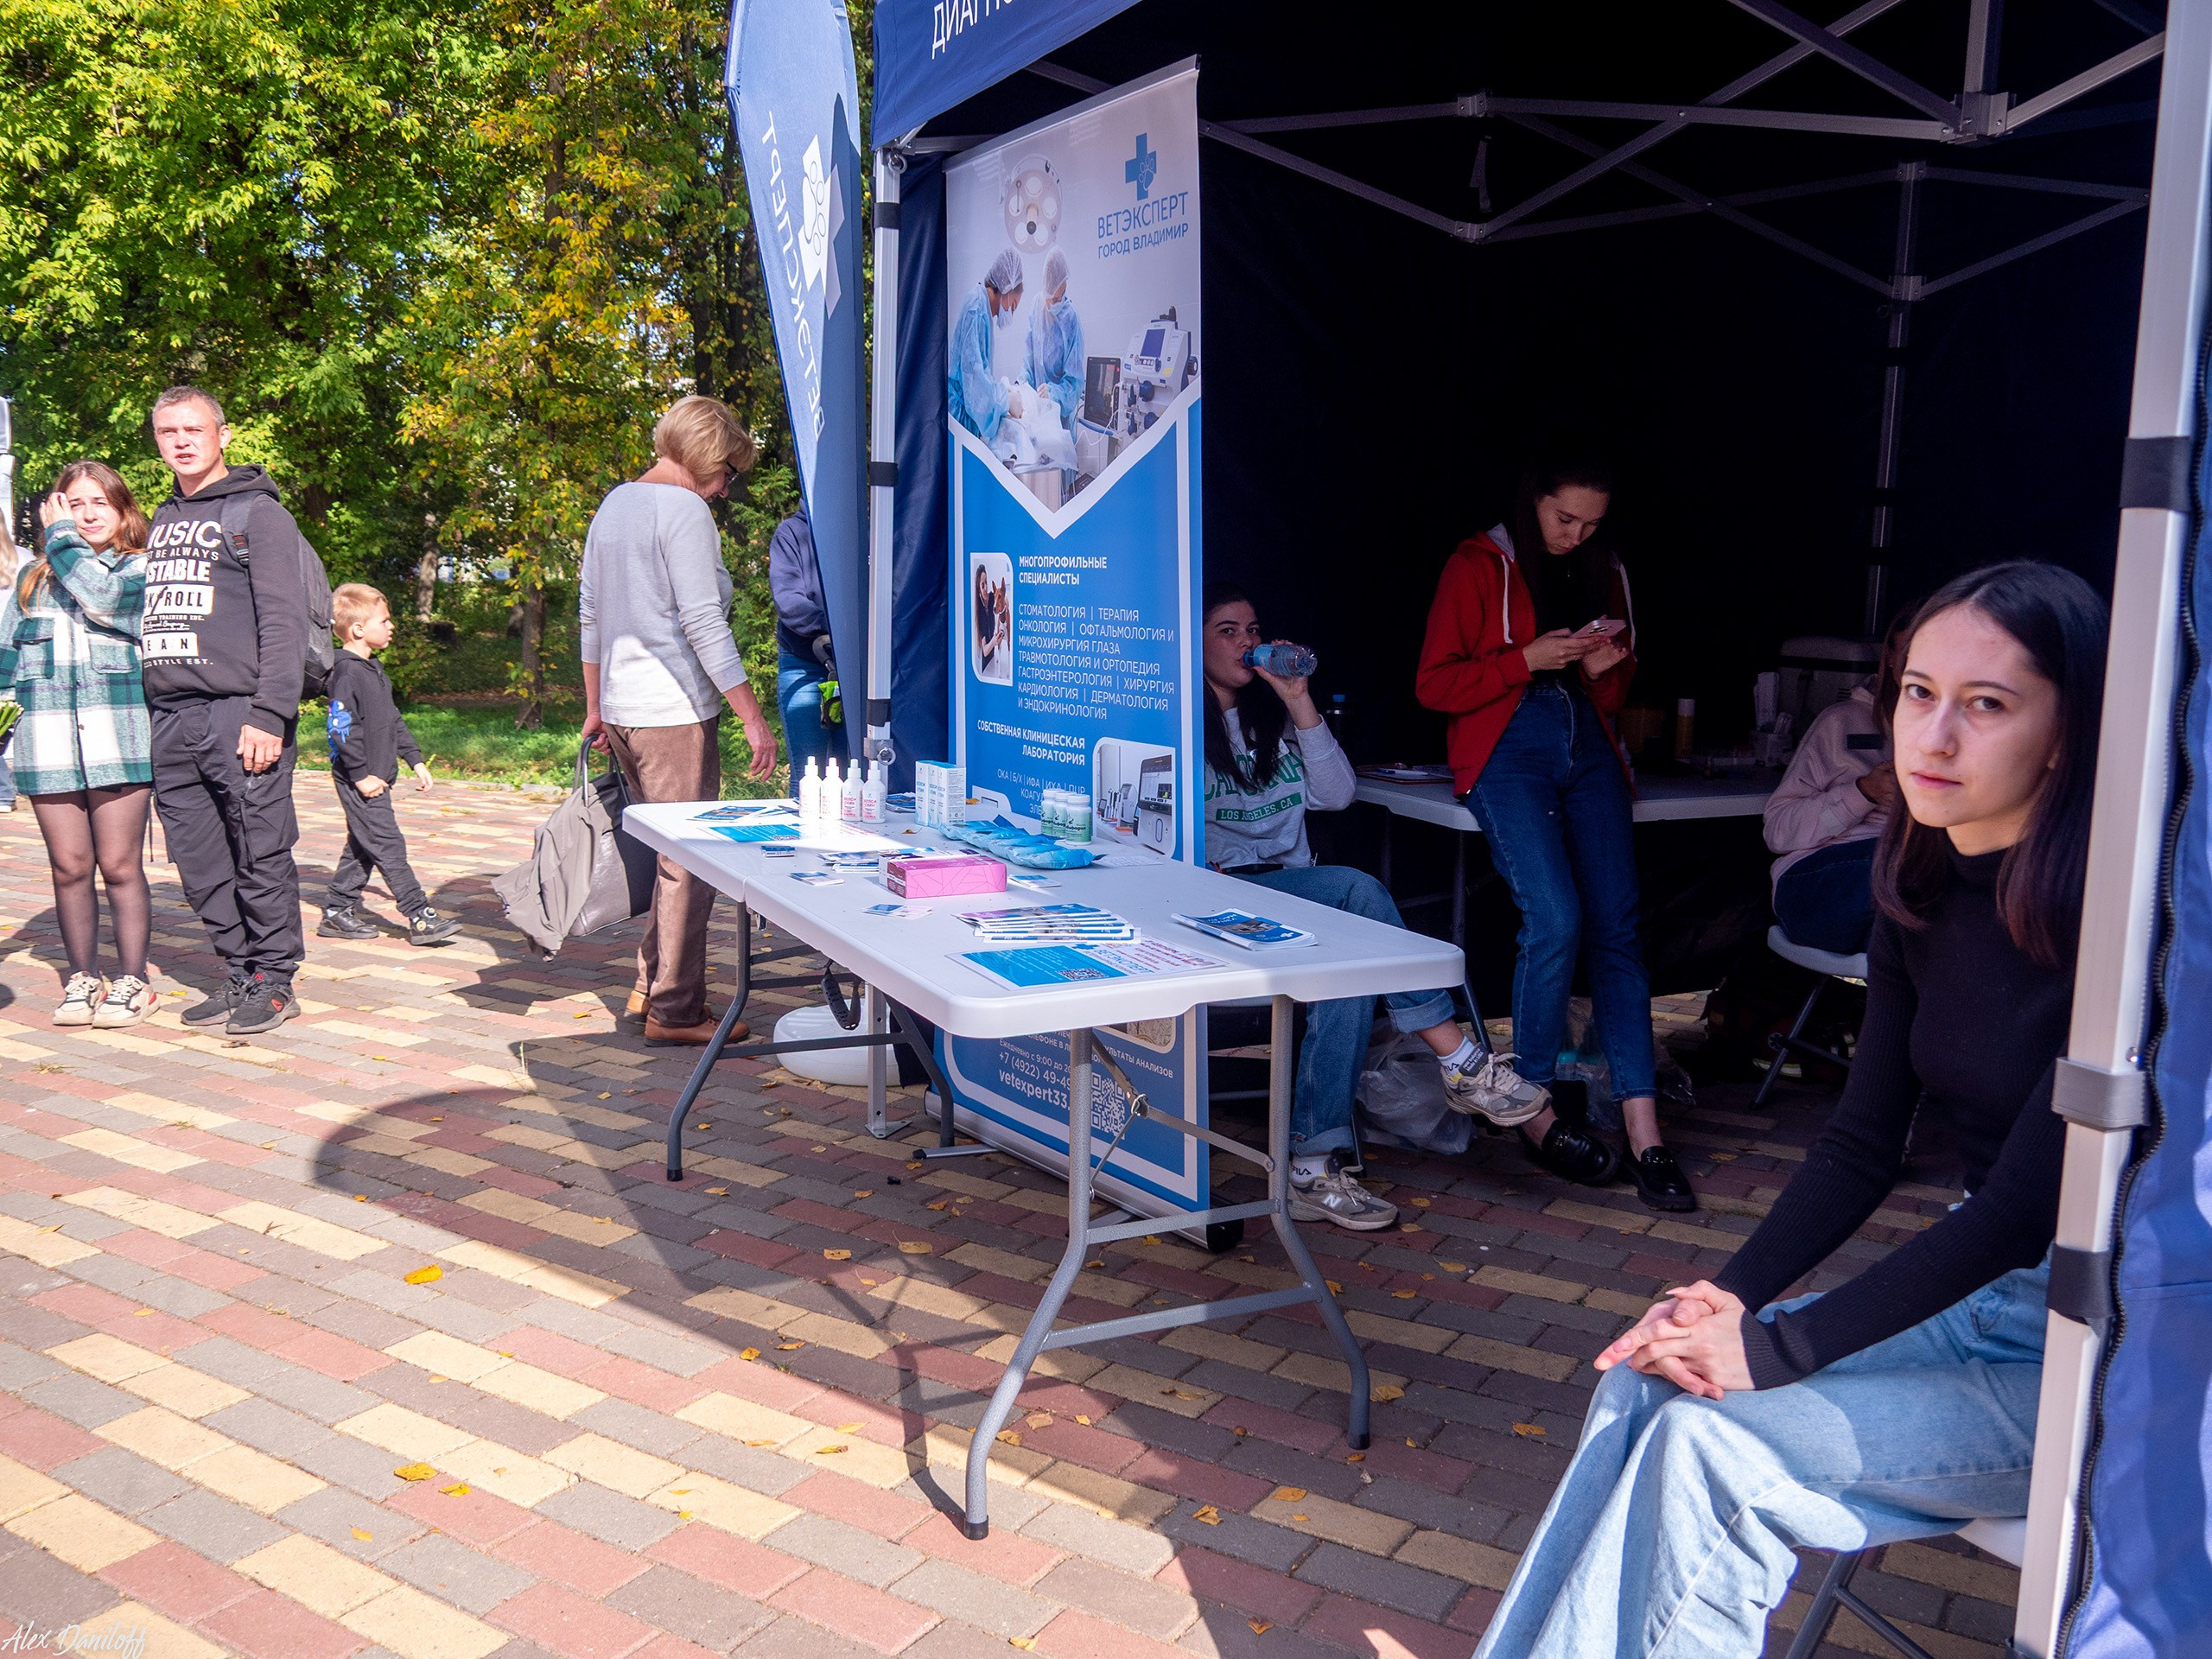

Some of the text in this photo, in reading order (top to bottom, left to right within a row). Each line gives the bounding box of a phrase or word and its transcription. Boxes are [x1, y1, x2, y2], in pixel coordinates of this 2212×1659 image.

[1097, 191, 1188, 239] ВЕТЭКСПЕРТ
[1098, 222, 1189, 259] ГОРОД ВЛАДИМИР
[156, 549, 168, 559] BE
[169, 546, 220, 561] ALWAYS
[1019, 556, 1107, 569] МНОГОПРОФИЛЬНЫЕ
[146, 558, 212, 584] STABLE
[1019, 572, 1080, 585] СПЕЦИАЛИСТЫ
[164, 591, 203, 607] ROLL
[1019, 603, 1139, 622] СТОМАТОЛОГИЯ ТЕРАПИЯ
[1019, 620, 1174, 642] ОНКОЛОГИЯ ОФТАЛЬМОЛОГИЯ И
[1018, 635, 1121, 655] МИКРОХИРУРГИЯ ГЛАЗА
[1018, 651, 1160, 676] ТРАВМОТОЛОГИЯ И ОРТОПЕДИЯ
[1018, 666, 1174, 695] ГАСТРОЭНТЕРОЛОГИЯ ХИРУРГИЯ
[1018, 682, 1168, 711] КАРДИОЛОГИЯ ДЕРМАТОЛОГИЯ
[1018, 697, 1107, 720] И ЭНДОКРИНОЛОГИЯ
[977, 720, 1021, 739] СОБСТВЕННАЯ
[1022, 744, 1085, 766] ЛАБОРАТОРИЯ
[1027, 776, 1040, 788] ИФА
[1020, 788, 1043, 802] КОАГУ
[1220, 810, 1239, 820] LOS
[1280, 798, 1294, 810] CA
[999, 1037, 1031, 1058] Ежедневно
[1036, 1053, 1052, 1066] 9:00
[1054, 1061, 1063, 1071] до
[999, 1052, 1010, 1065] +7
[1011, 1055, 1040, 1080] (4922)
[1135, 1058, 1173, 1078] АНАЛИЗОВ
